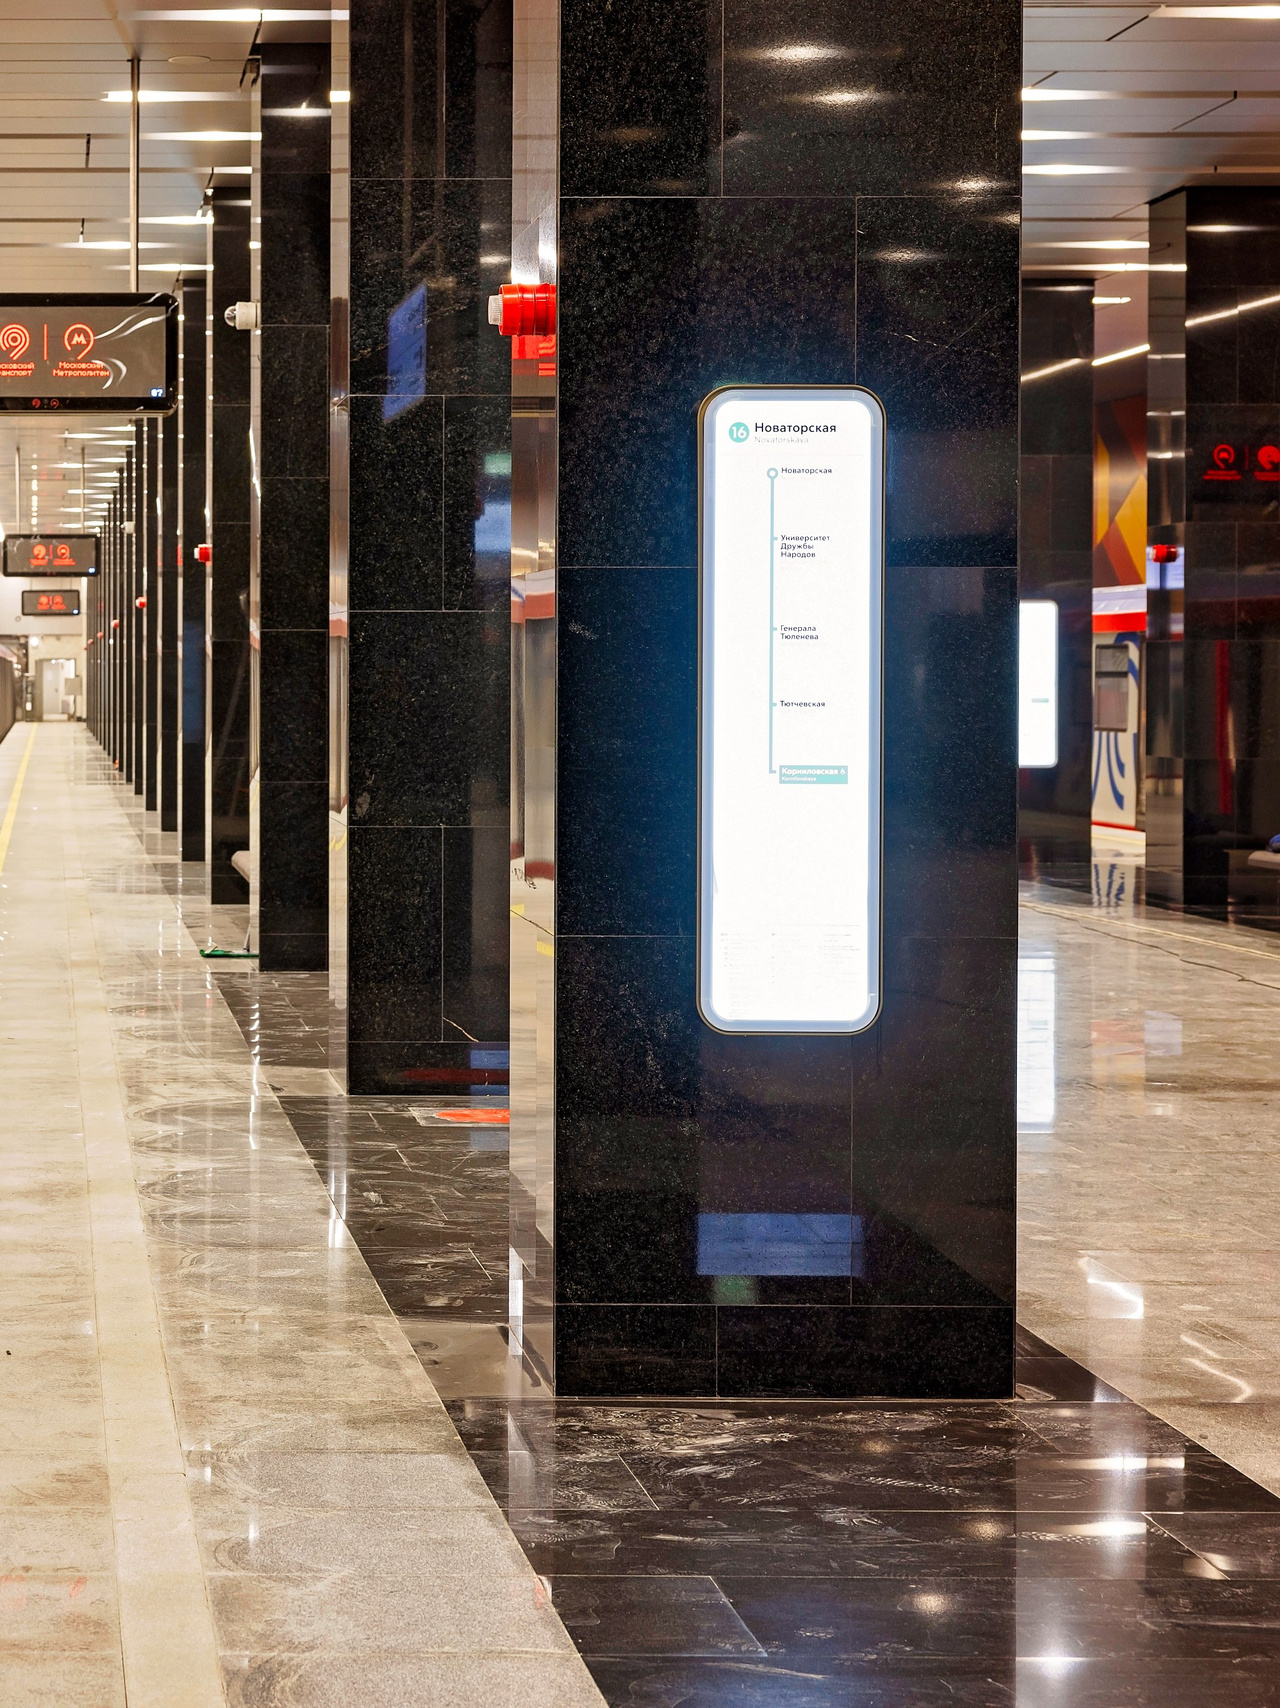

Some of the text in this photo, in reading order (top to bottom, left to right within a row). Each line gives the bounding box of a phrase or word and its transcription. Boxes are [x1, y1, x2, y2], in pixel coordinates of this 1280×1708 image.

[53, 369, 110, 377] Метрополитен
[732, 422, 837, 439] 16 Новаторская
[781, 467, 833, 475] Новаторская
[780, 534, 831, 542] Университет
[780, 543, 814, 551] Дружбы
[780, 551, 816, 559] Народов
[780, 625, 817, 633] Генерала
[780, 700, 826, 708] Тютчевская
[781, 767, 839, 776] Корниловская
